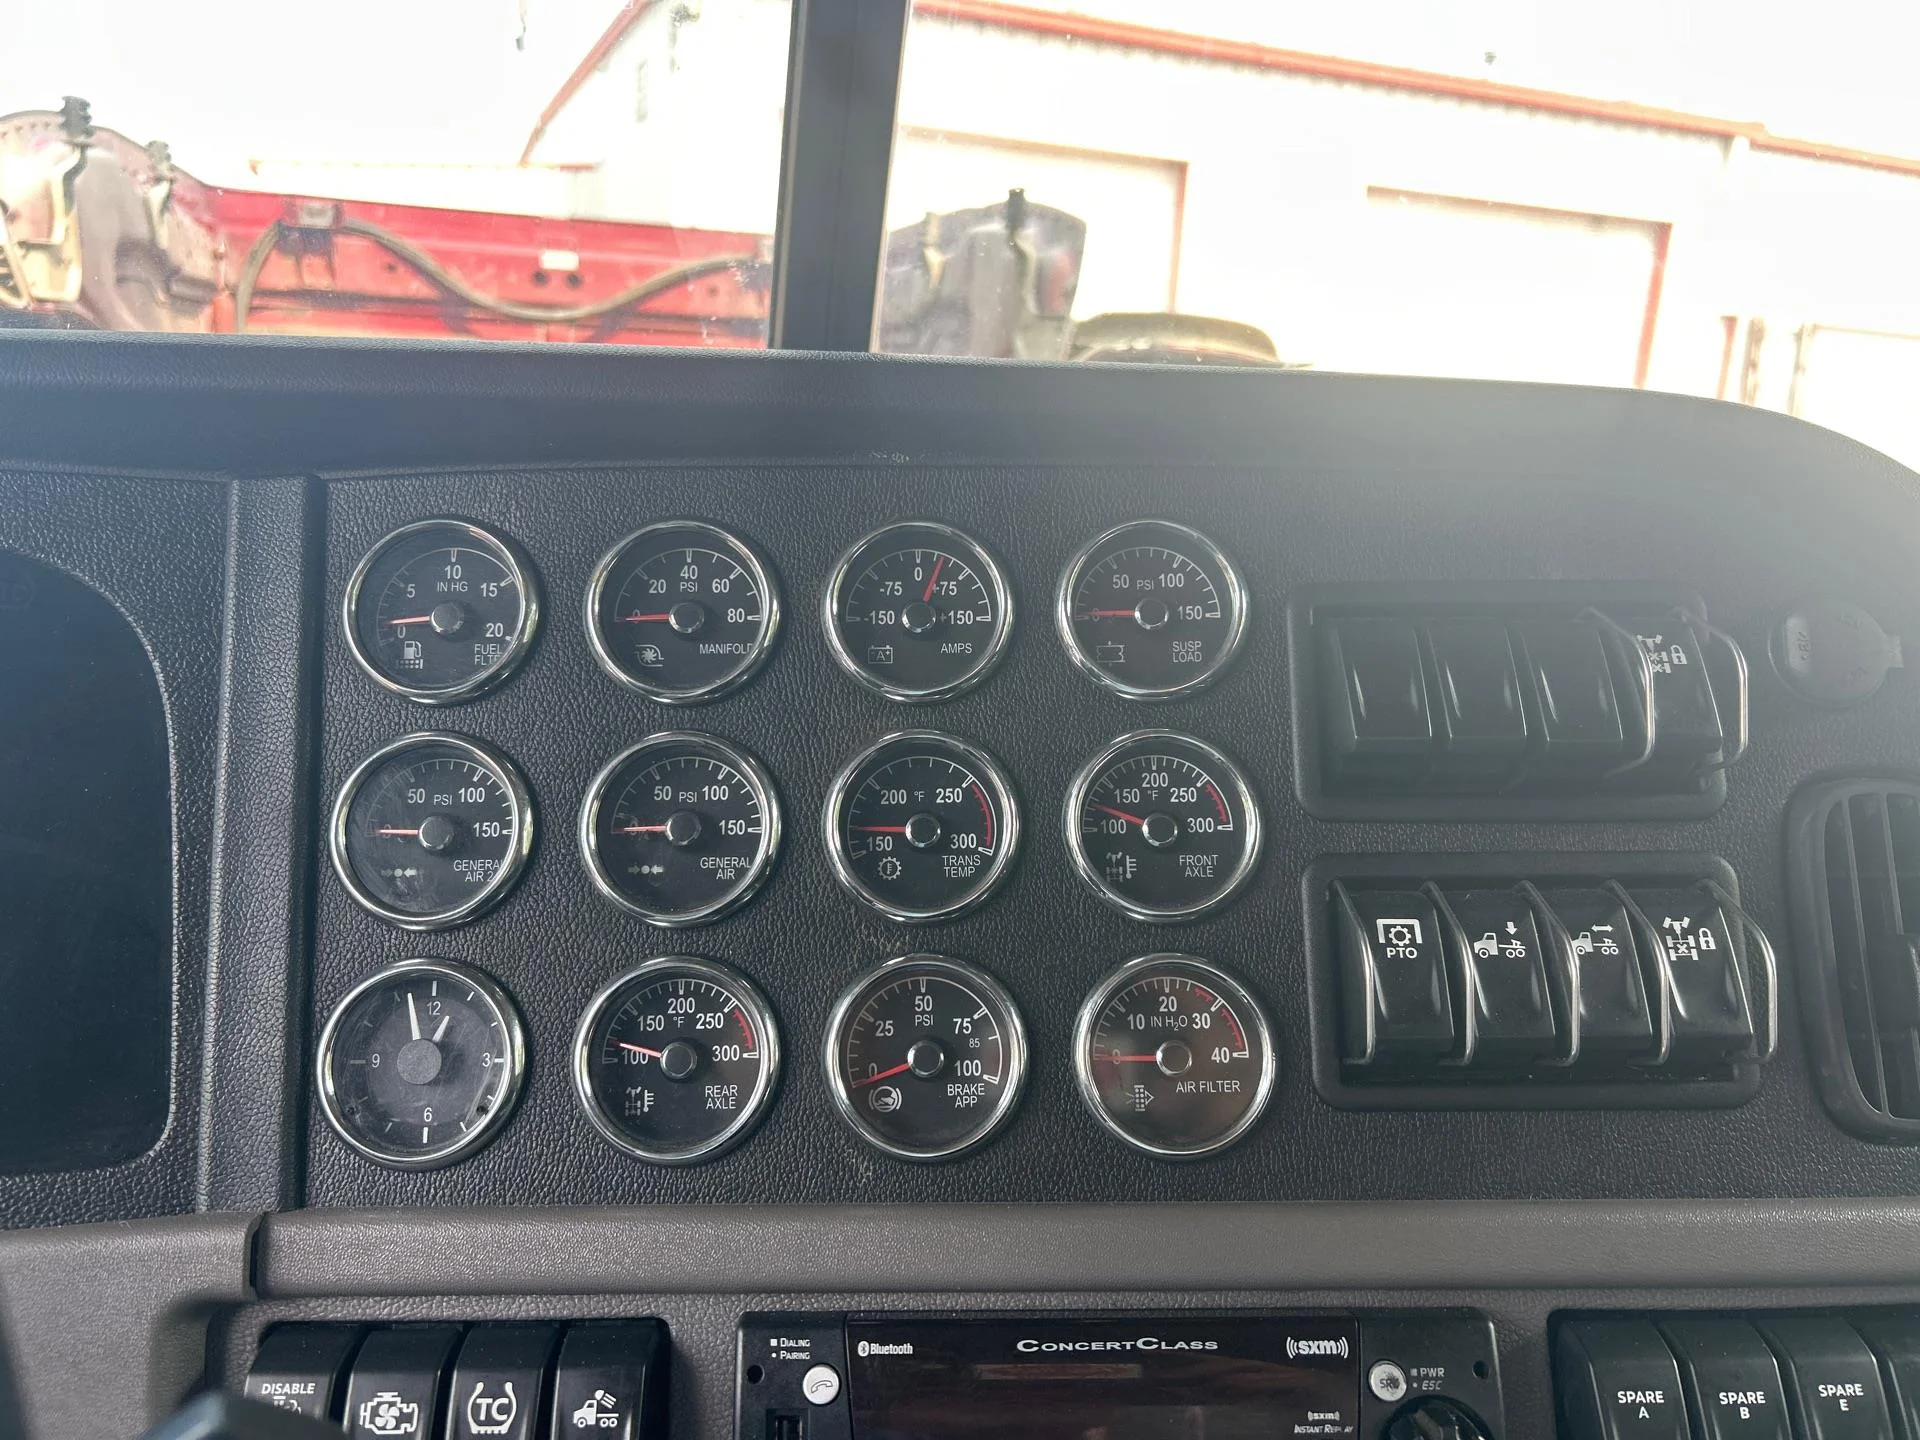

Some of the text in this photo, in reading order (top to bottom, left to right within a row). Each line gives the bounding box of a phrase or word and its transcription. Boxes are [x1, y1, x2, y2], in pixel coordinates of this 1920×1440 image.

[444, 565, 461, 579] 10
[680, 565, 698, 579] 40
[914, 567, 922, 581] 0
[437, 582, 468, 592] IN HG
[649, 579, 666, 593] 20
[680, 582, 697, 592] PSI
[712, 579, 729, 593] 60
[1112, 575, 1129, 588] 50
[1136, 580, 1154, 590] PSI
[1159, 573, 1184, 588] 100
[406, 584, 415, 598] 5
[481, 583, 498, 597] 15
[880, 582, 902, 596] -75
[727, 608, 745, 623] 80
[864, 611, 895, 625] -150
[940, 610, 974, 624] +150
[1177, 606, 1203, 620] 150
[397, 625, 406, 638] 0
[485, 623, 503, 637] 20
[474, 644, 503, 655] FUEL
[940, 643, 973, 653] AMPS
[1172, 641, 1202, 652] SUSP
[1172, 652, 1202, 662] LOAD
[1142, 772, 1168, 788] 200
[407, 788, 425, 803] 50
[433, 794, 453, 806] PSI
[459, 787, 485, 803] 100
[654, 786, 672, 800] 50
[679, 791, 698, 802] PSI
[702, 786, 729, 800] 100
[881, 790, 907, 804] 200
[936, 788, 962, 803] 250
[1114, 788, 1140, 803] 150
[1170, 788, 1197, 802] 250
[473, 822, 500, 837] 150
[719, 820, 745, 835] 150
[1100, 819, 1127, 834] 100
[1187, 818, 1214, 833] 300
[867, 836, 892, 851] 150
[950, 833, 977, 848] 300
[700, 857, 751, 868] GENERAL
[942, 855, 981, 866] TRANS
[1179, 855, 1219, 866] FRONT
[465, 871, 484, 882] AIR
[716, 868, 735, 880] AIR
[944, 867, 975, 878] TEMP
[1185, 866, 1214, 877] AXLE
[1386, 947, 1418, 959] PTO
[427, 1002, 441, 1016] 12
[667, 998, 695, 1014] 200
[915, 996, 933, 1011] 50
[1159, 996, 1177, 1012] 20
[637, 1015, 664, 1031] 150
[696, 1013, 723, 1029] 250
[915, 1015, 934, 1026] PSI
[953, 1018, 971, 1034] 75
[1128, 1014, 1145, 1030] 10
[1150, 1017, 1162, 1027] IN
[1192, 1013, 1211, 1029] 30
[876, 1020, 894, 1036] 25
[969, 1038, 980, 1048] 85
[482, 1052, 490, 1067] 3
[712, 1045, 740, 1061] 300
[1211, 1047, 1230, 1063] 40
[371, 1053, 380, 1068] 9
[954, 1060, 981, 1076] 100
[705, 1085, 737, 1097] REAR
[947, 1084, 985, 1095] BRAKE
[1176, 1081, 1241, 1093] AIR FILTER
[706, 1097, 736, 1109] AXLE
[955, 1096, 978, 1107] APP
[423, 1107, 433, 1122] 6
[870, 1343, 913, 1354] Bluetooth
[1420, 1367, 1445, 1378] PWR
[262, 1383, 316, 1394] DISABLE
[1422, 1380, 1443, 1390] ESC
[1818, 1383, 1864, 1398] SPARE
[1617, 1390, 1664, 1404] SPARE
[1719, 1391, 1766, 1405] SPARE
[476, 1397, 509, 1421] TC
[1638, 1406, 1650, 1419] A
[1840, 1399, 1849, 1412] E
[1740, 1407, 1750, 1420] B
